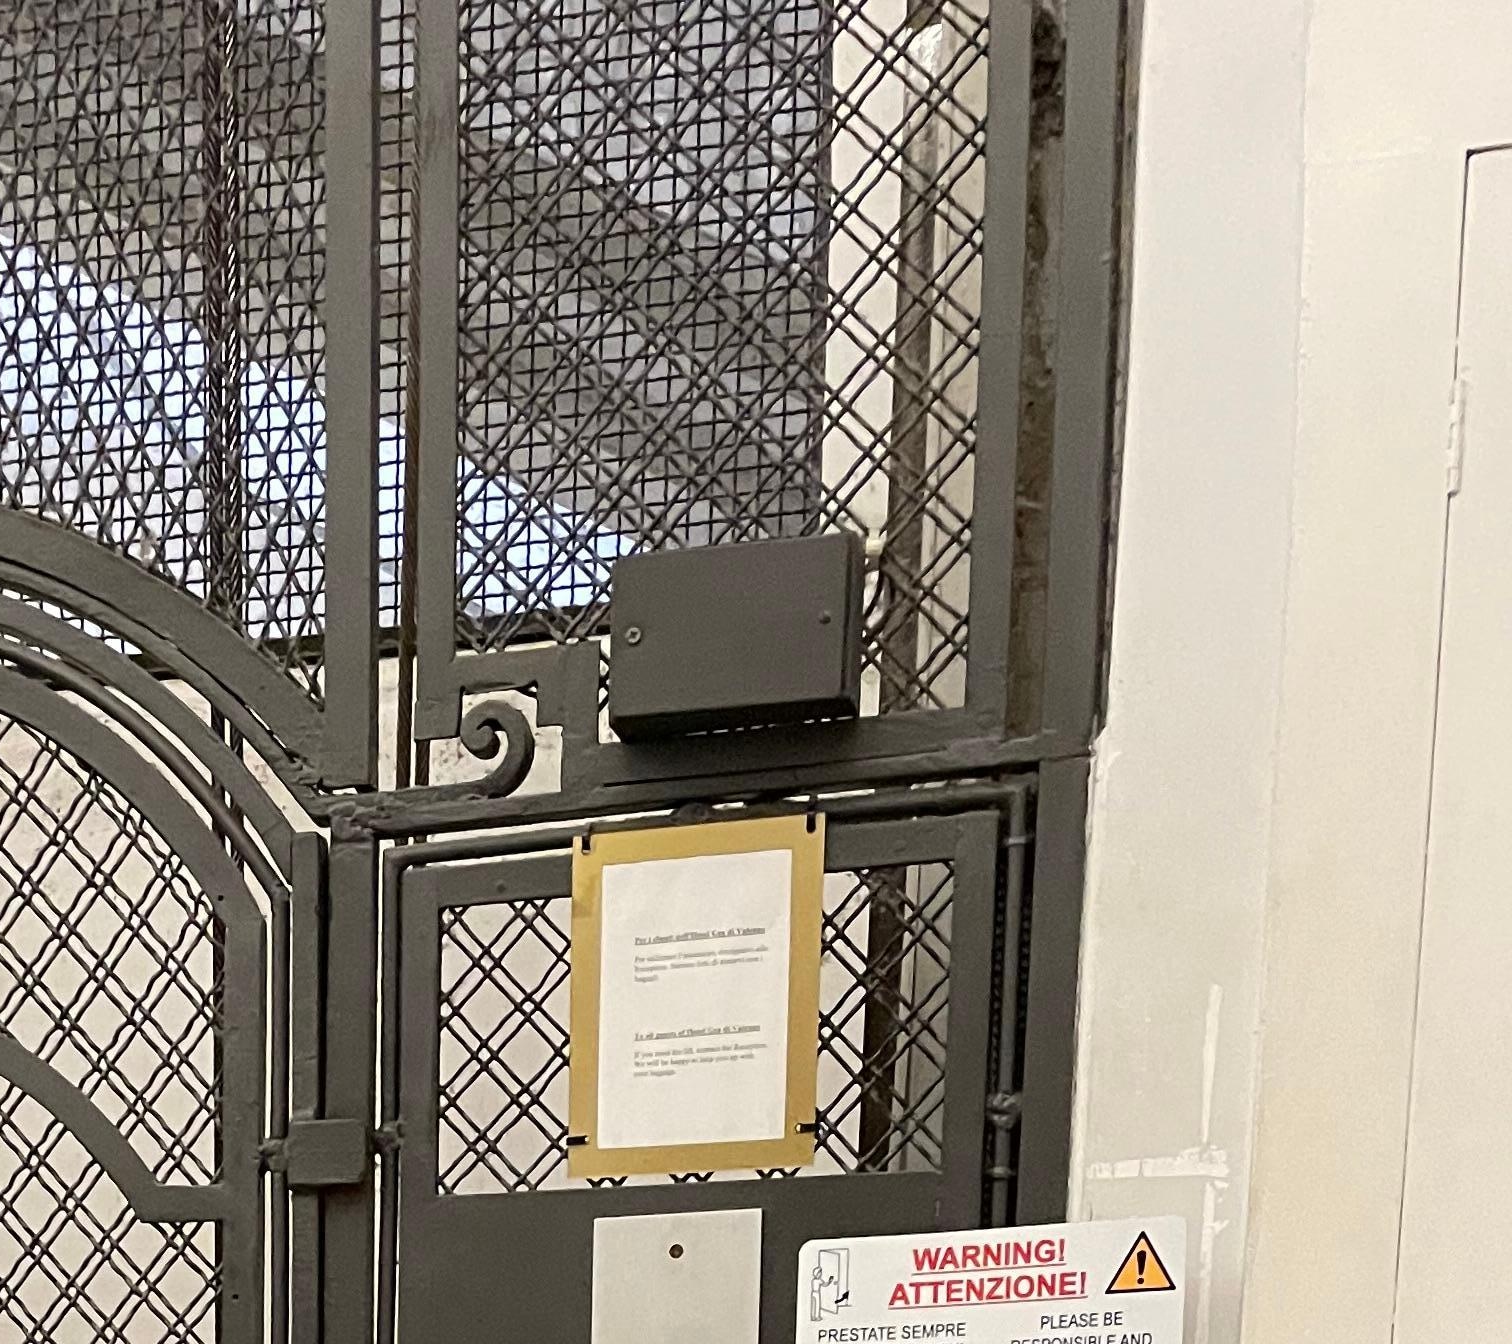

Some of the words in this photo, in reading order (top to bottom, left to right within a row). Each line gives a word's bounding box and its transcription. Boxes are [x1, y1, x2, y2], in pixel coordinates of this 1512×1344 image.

[912, 1238, 1066, 1271] WARNING!
[888, 1271, 1087, 1306] ATTENZIONE!
[818, 1326, 896, 1342] PRESTATE
[901, 1322, 966, 1339] SEMPRE
[1040, 1313, 1098, 1330] PLEASE
[1103, 1311, 1123, 1326] BE
